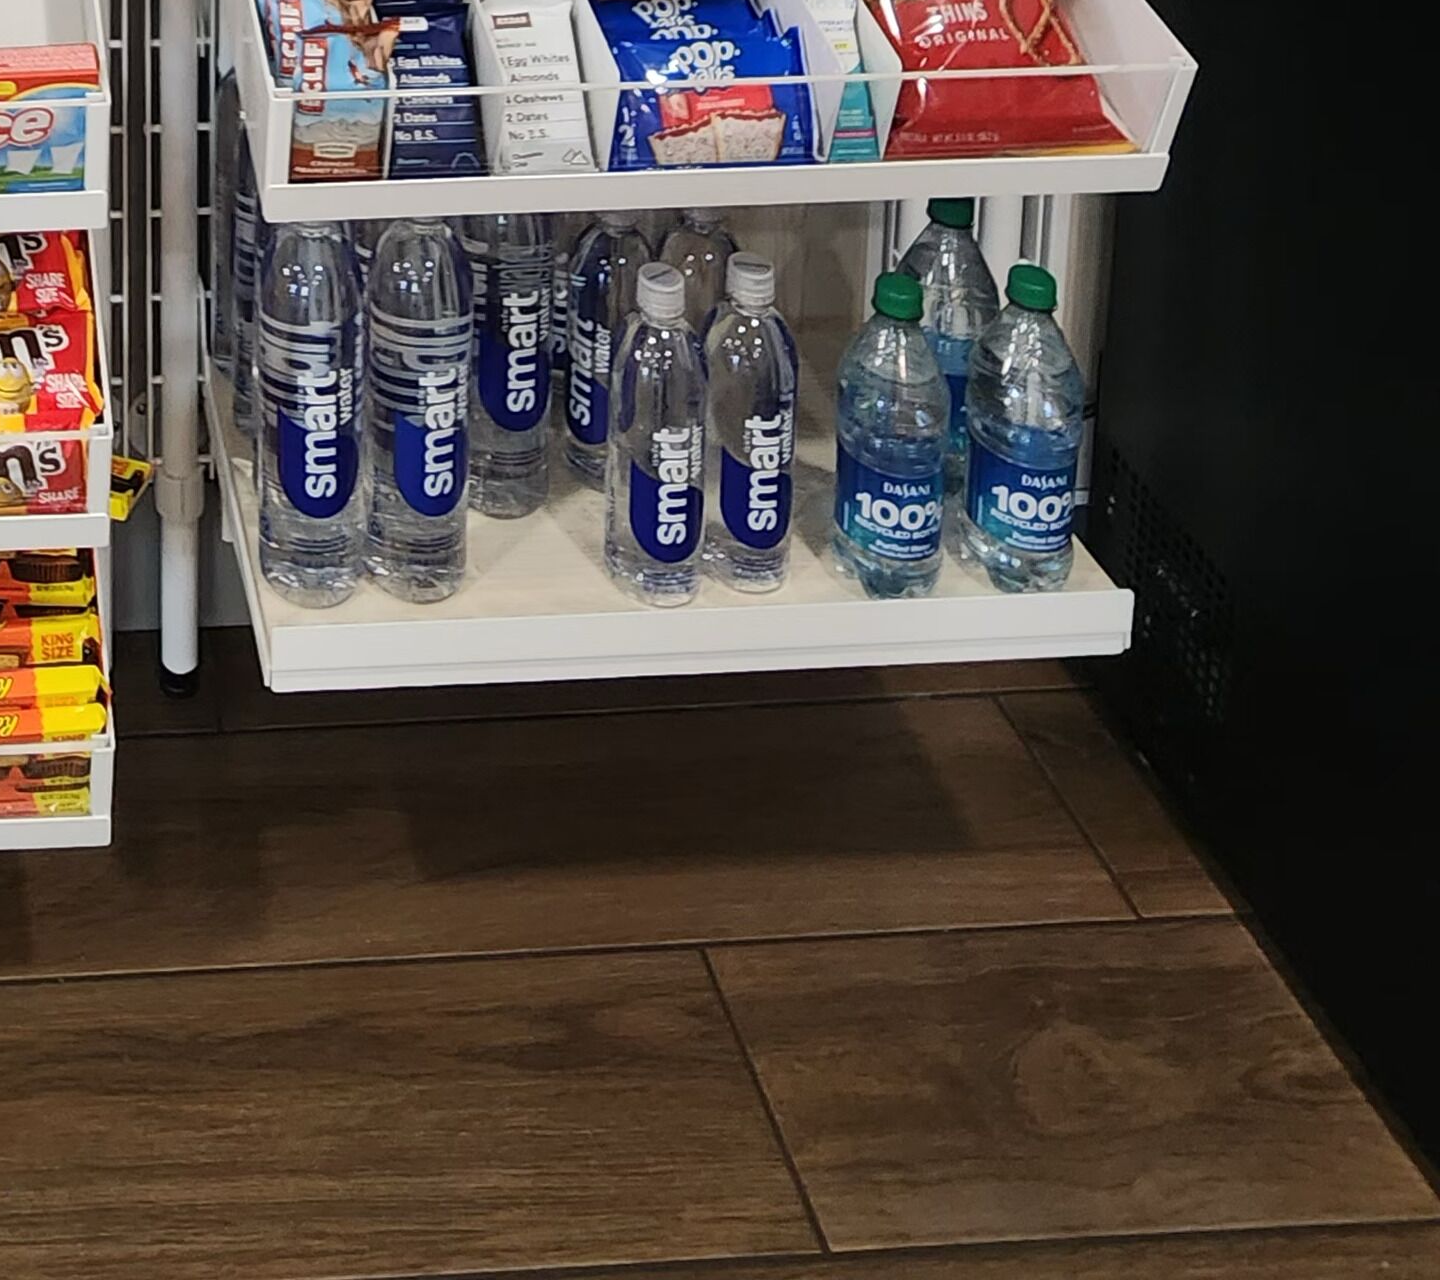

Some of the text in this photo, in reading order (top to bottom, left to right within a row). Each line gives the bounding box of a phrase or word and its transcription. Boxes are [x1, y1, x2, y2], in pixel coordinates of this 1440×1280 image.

[926, 1, 988, 23] THINS
[916, 27, 1009, 49] ORIGINAL
[47, 373, 88, 392] SHARE
[299, 371, 337, 499] smart
[418, 368, 455, 496] smart
[660, 427, 691, 545] smart
[883, 483, 931, 498] DASANI
[856, 492, 943, 530] 100%
[42, 633, 75, 647] KING
[41, 646, 75, 660] SIZE
